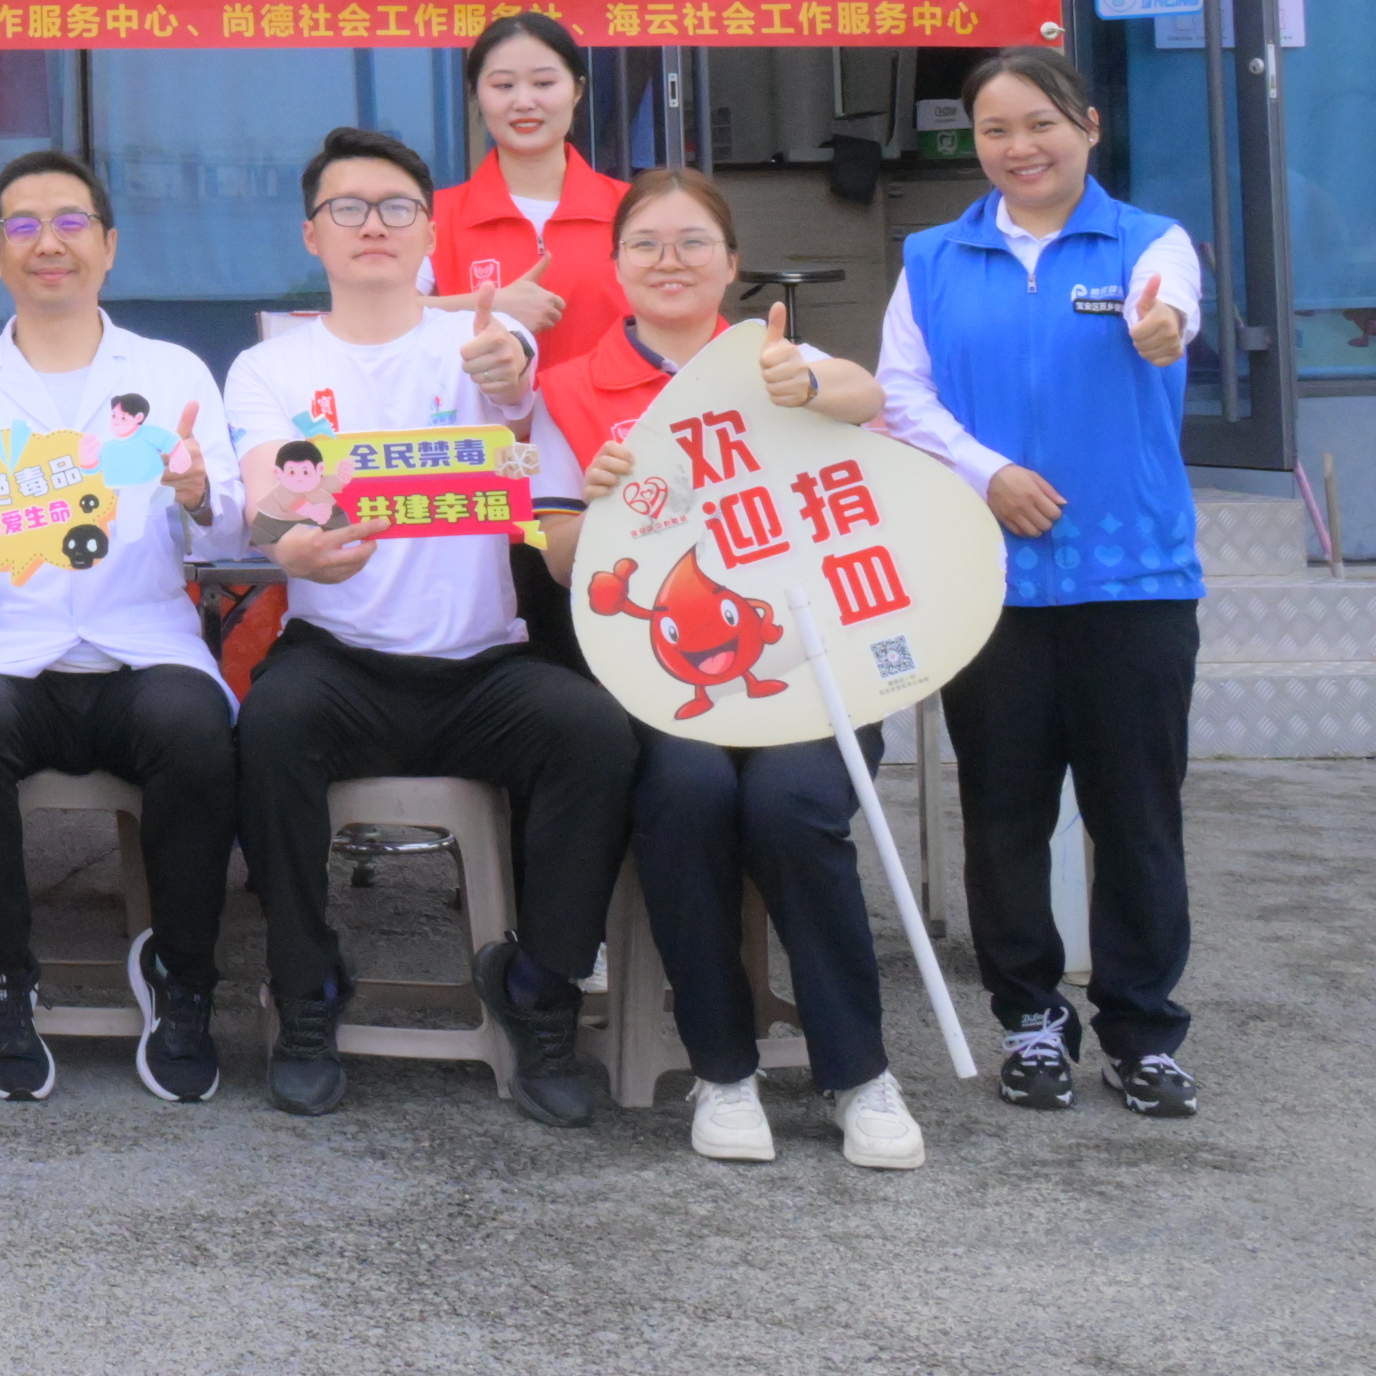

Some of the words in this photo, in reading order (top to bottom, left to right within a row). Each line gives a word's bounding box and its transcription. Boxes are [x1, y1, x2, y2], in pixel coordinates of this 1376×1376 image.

[349, 438, 486, 470] 全民禁毒
[669, 409, 792, 571] 欢迎
[355, 490, 512, 525] 共建幸福
[790, 458, 912, 627] 捐血
